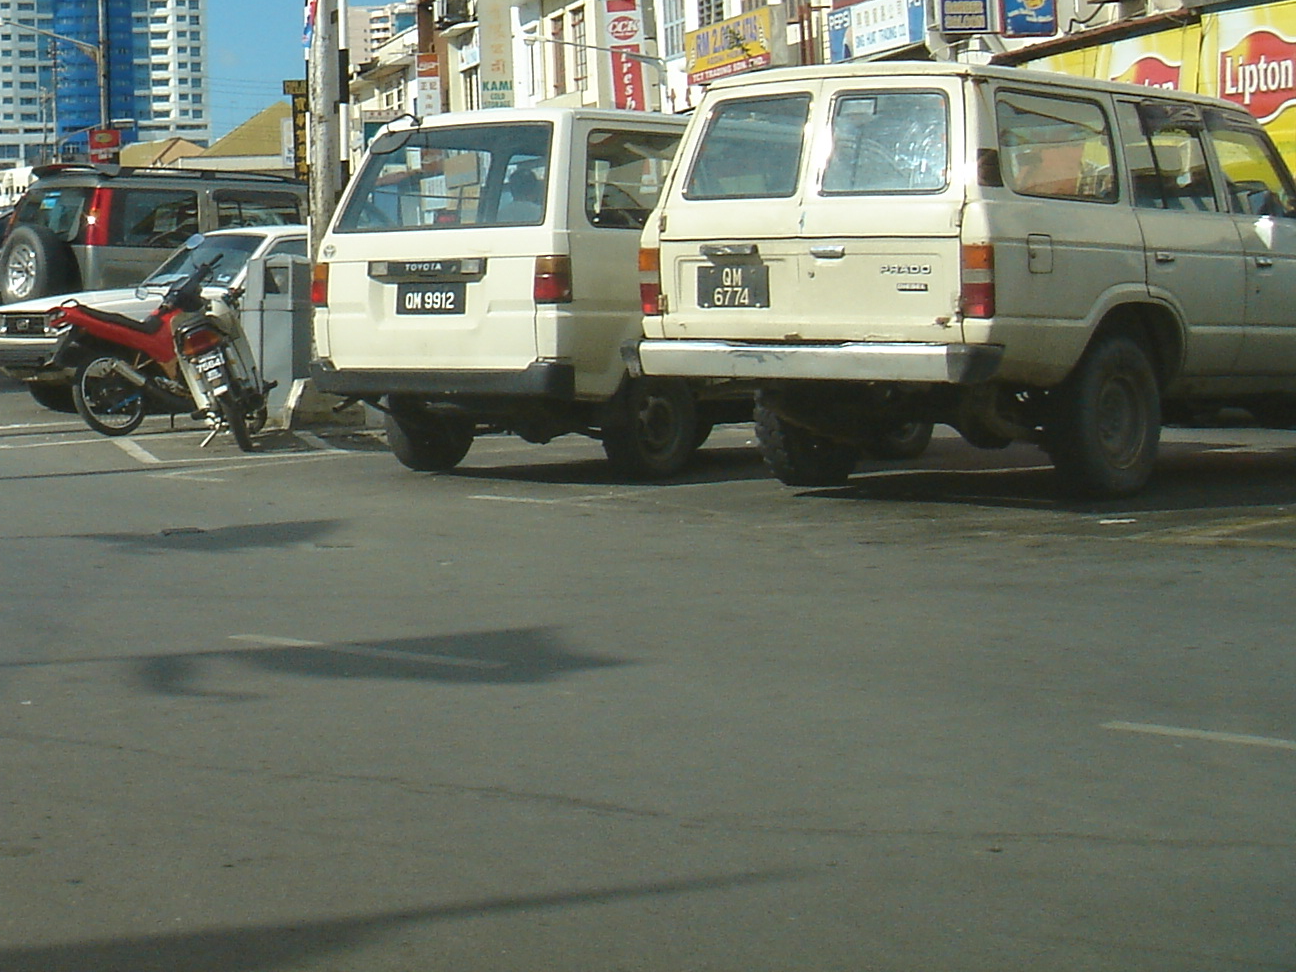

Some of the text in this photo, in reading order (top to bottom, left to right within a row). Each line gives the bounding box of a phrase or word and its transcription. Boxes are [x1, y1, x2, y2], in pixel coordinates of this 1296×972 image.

[608, 20, 640, 33] CCK
[482, 80, 513, 91] KAMI
[1225, 55, 1294, 105] Lipton
[405, 262, 442, 272] TOYOTA
[880, 264, 932, 275] PRADO
[721, 268, 742, 287] QM
[405, 291, 455, 310] QM 9912
[713, 287, 750, 306] 6774
